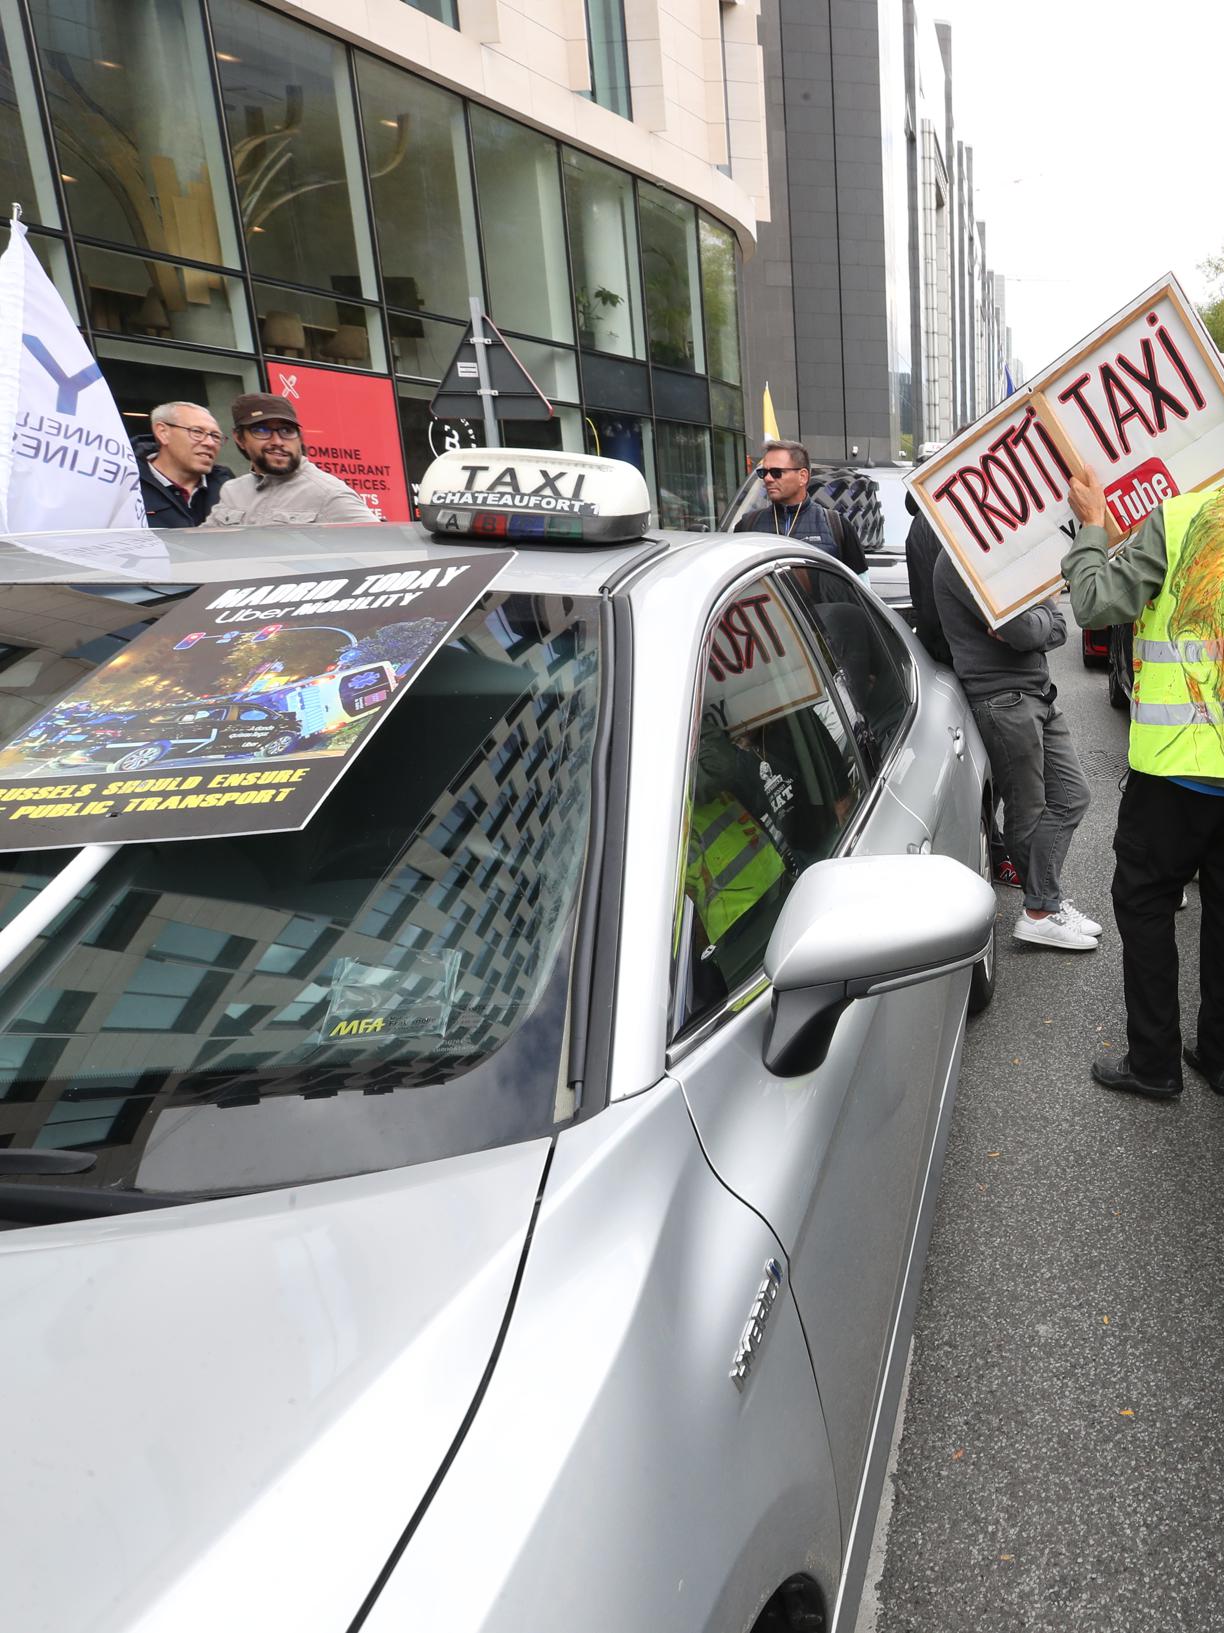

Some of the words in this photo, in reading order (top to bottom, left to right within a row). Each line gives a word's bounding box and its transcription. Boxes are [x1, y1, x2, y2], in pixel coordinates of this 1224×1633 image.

[306, 446, 362, 461] OMBINE
[314, 461, 391, 477] ESTAURANT
[343, 477, 391, 491] FFICES.
[461, 465, 586, 499] TAXI
[432, 492, 585, 513] CHATEAUFORT
[1106, 470, 1173, 526] Tube
[445, 513, 460, 530] A
[206, 578, 349, 610] MADRID
[351, 565, 471, 595] TODAY
[215, 606, 295, 624] Uber
[292, 591, 424, 617] MOBILITY
[102, 775, 203, 796] SHOULD
[207, 768, 311, 789] ENSURE
[9, 800, 114, 820] PUBLIC
[122, 787, 296, 813] TRANSPORT
[329, 1016, 385, 1037] MFA
